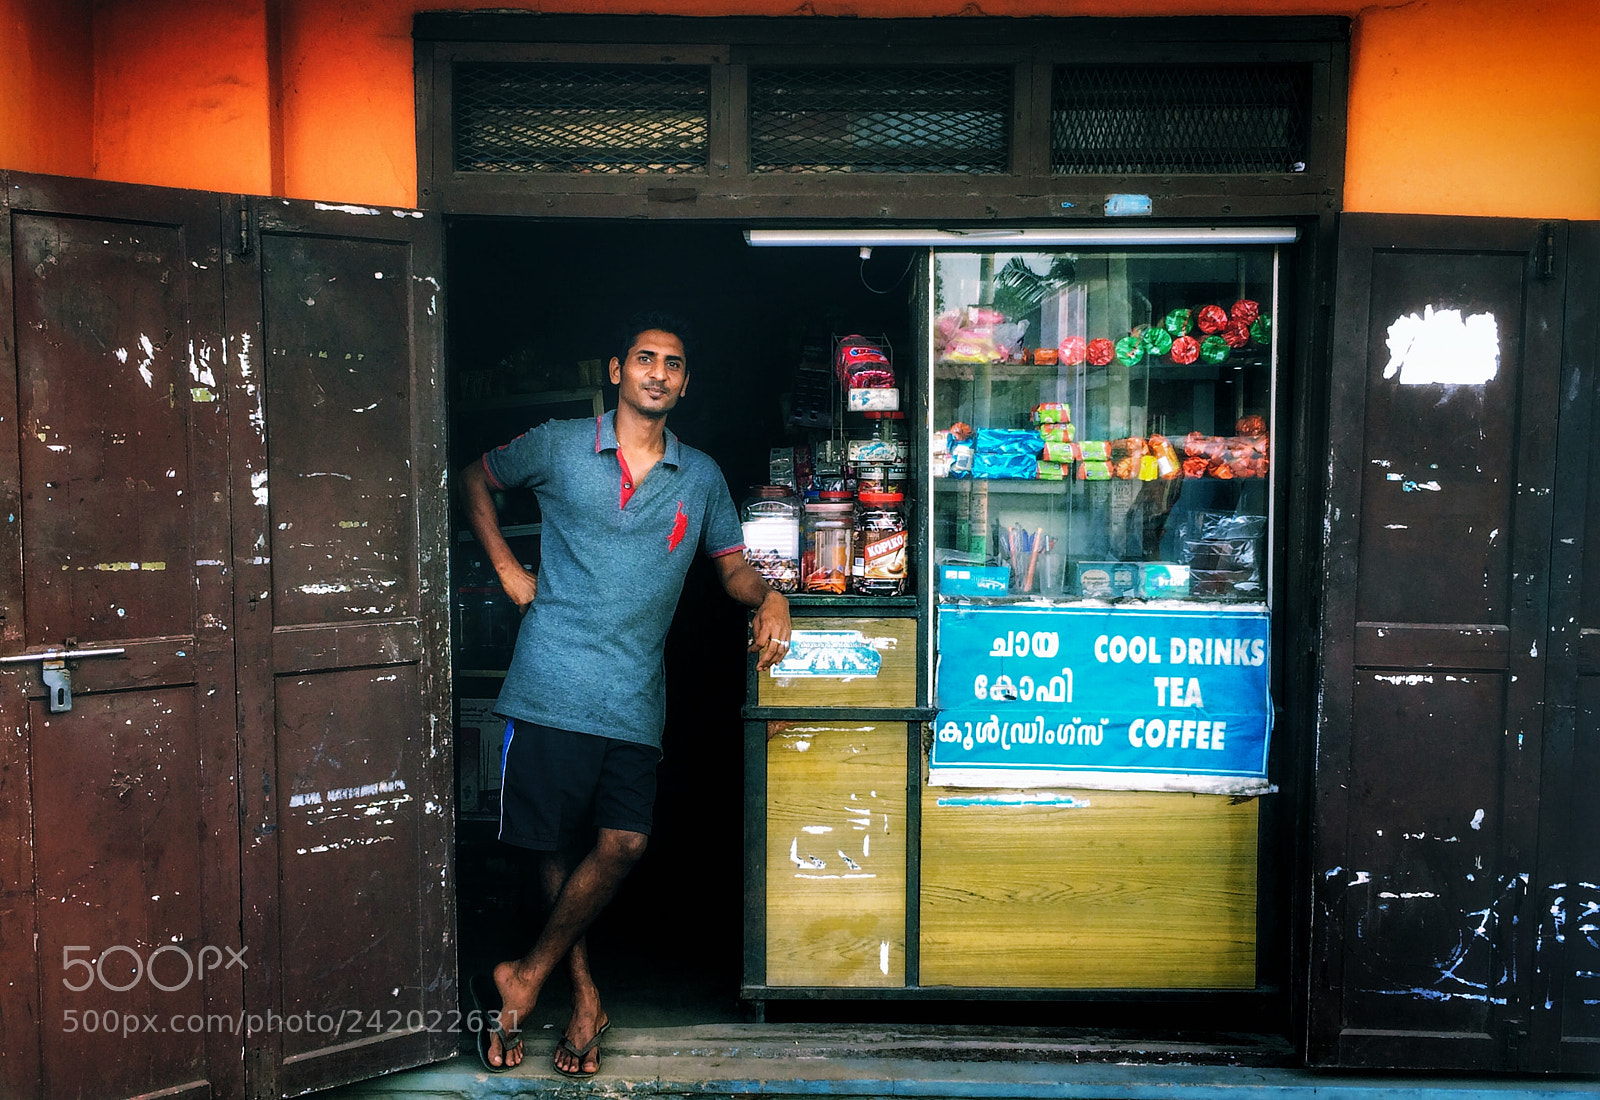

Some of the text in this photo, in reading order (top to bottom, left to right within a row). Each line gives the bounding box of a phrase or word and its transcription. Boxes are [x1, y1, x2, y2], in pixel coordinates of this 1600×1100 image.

[866, 533, 904, 558] KOPIKO
[989, 630, 1060, 658] ചായ
[1094, 634, 1265, 667] COOL DRINKS
[974, 667, 1073, 703] കോഫി
[1153, 676, 1204, 708] TEA
[1128, 718, 1227, 751] COFFEE
